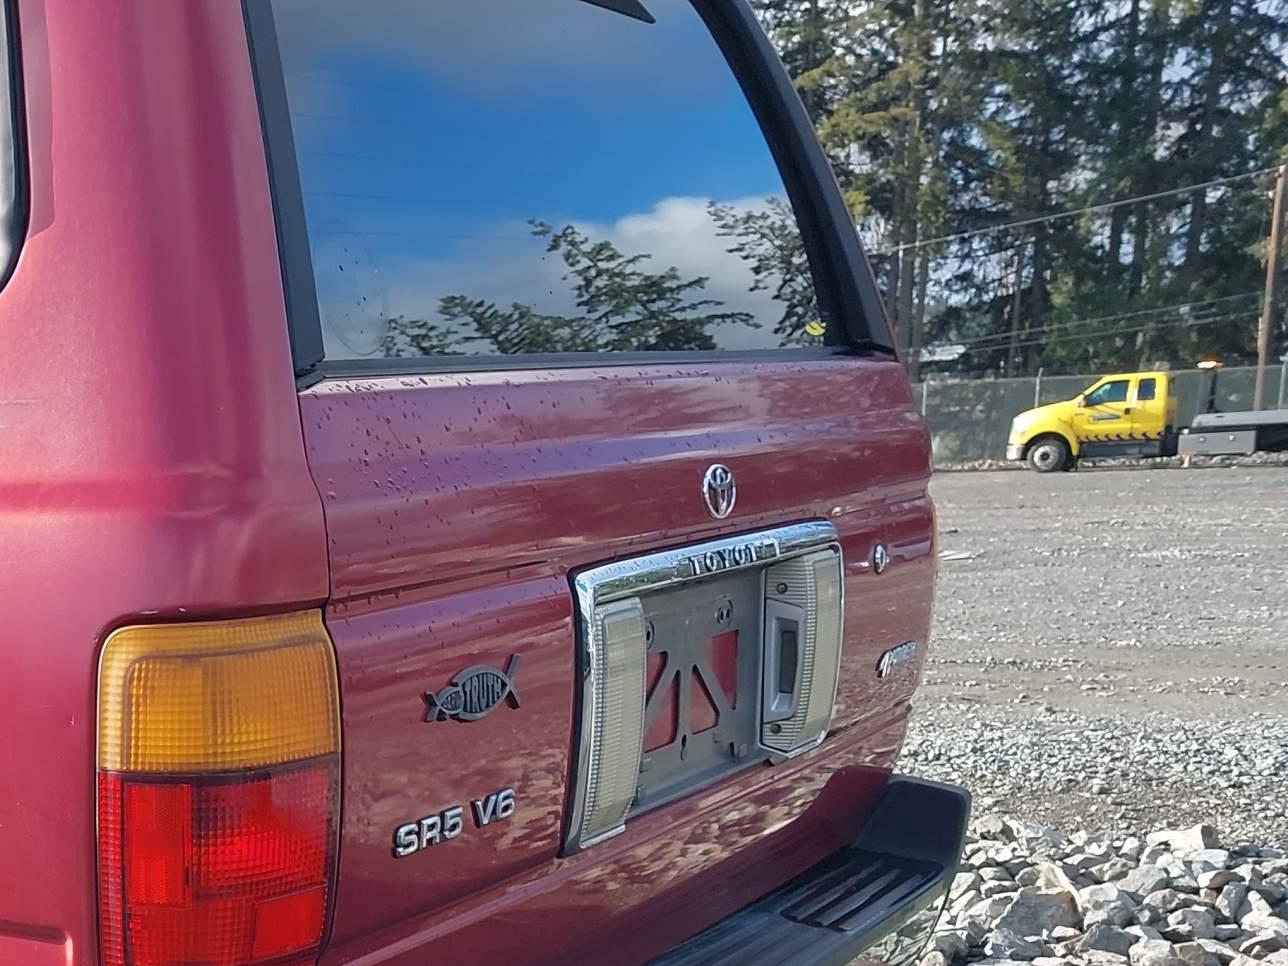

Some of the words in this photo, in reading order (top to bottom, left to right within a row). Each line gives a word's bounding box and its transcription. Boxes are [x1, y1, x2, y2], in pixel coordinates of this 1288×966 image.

[464, 672, 502, 713] TRUTH
[393, 805, 463, 858] SR5
[470, 787, 516, 828] V6
